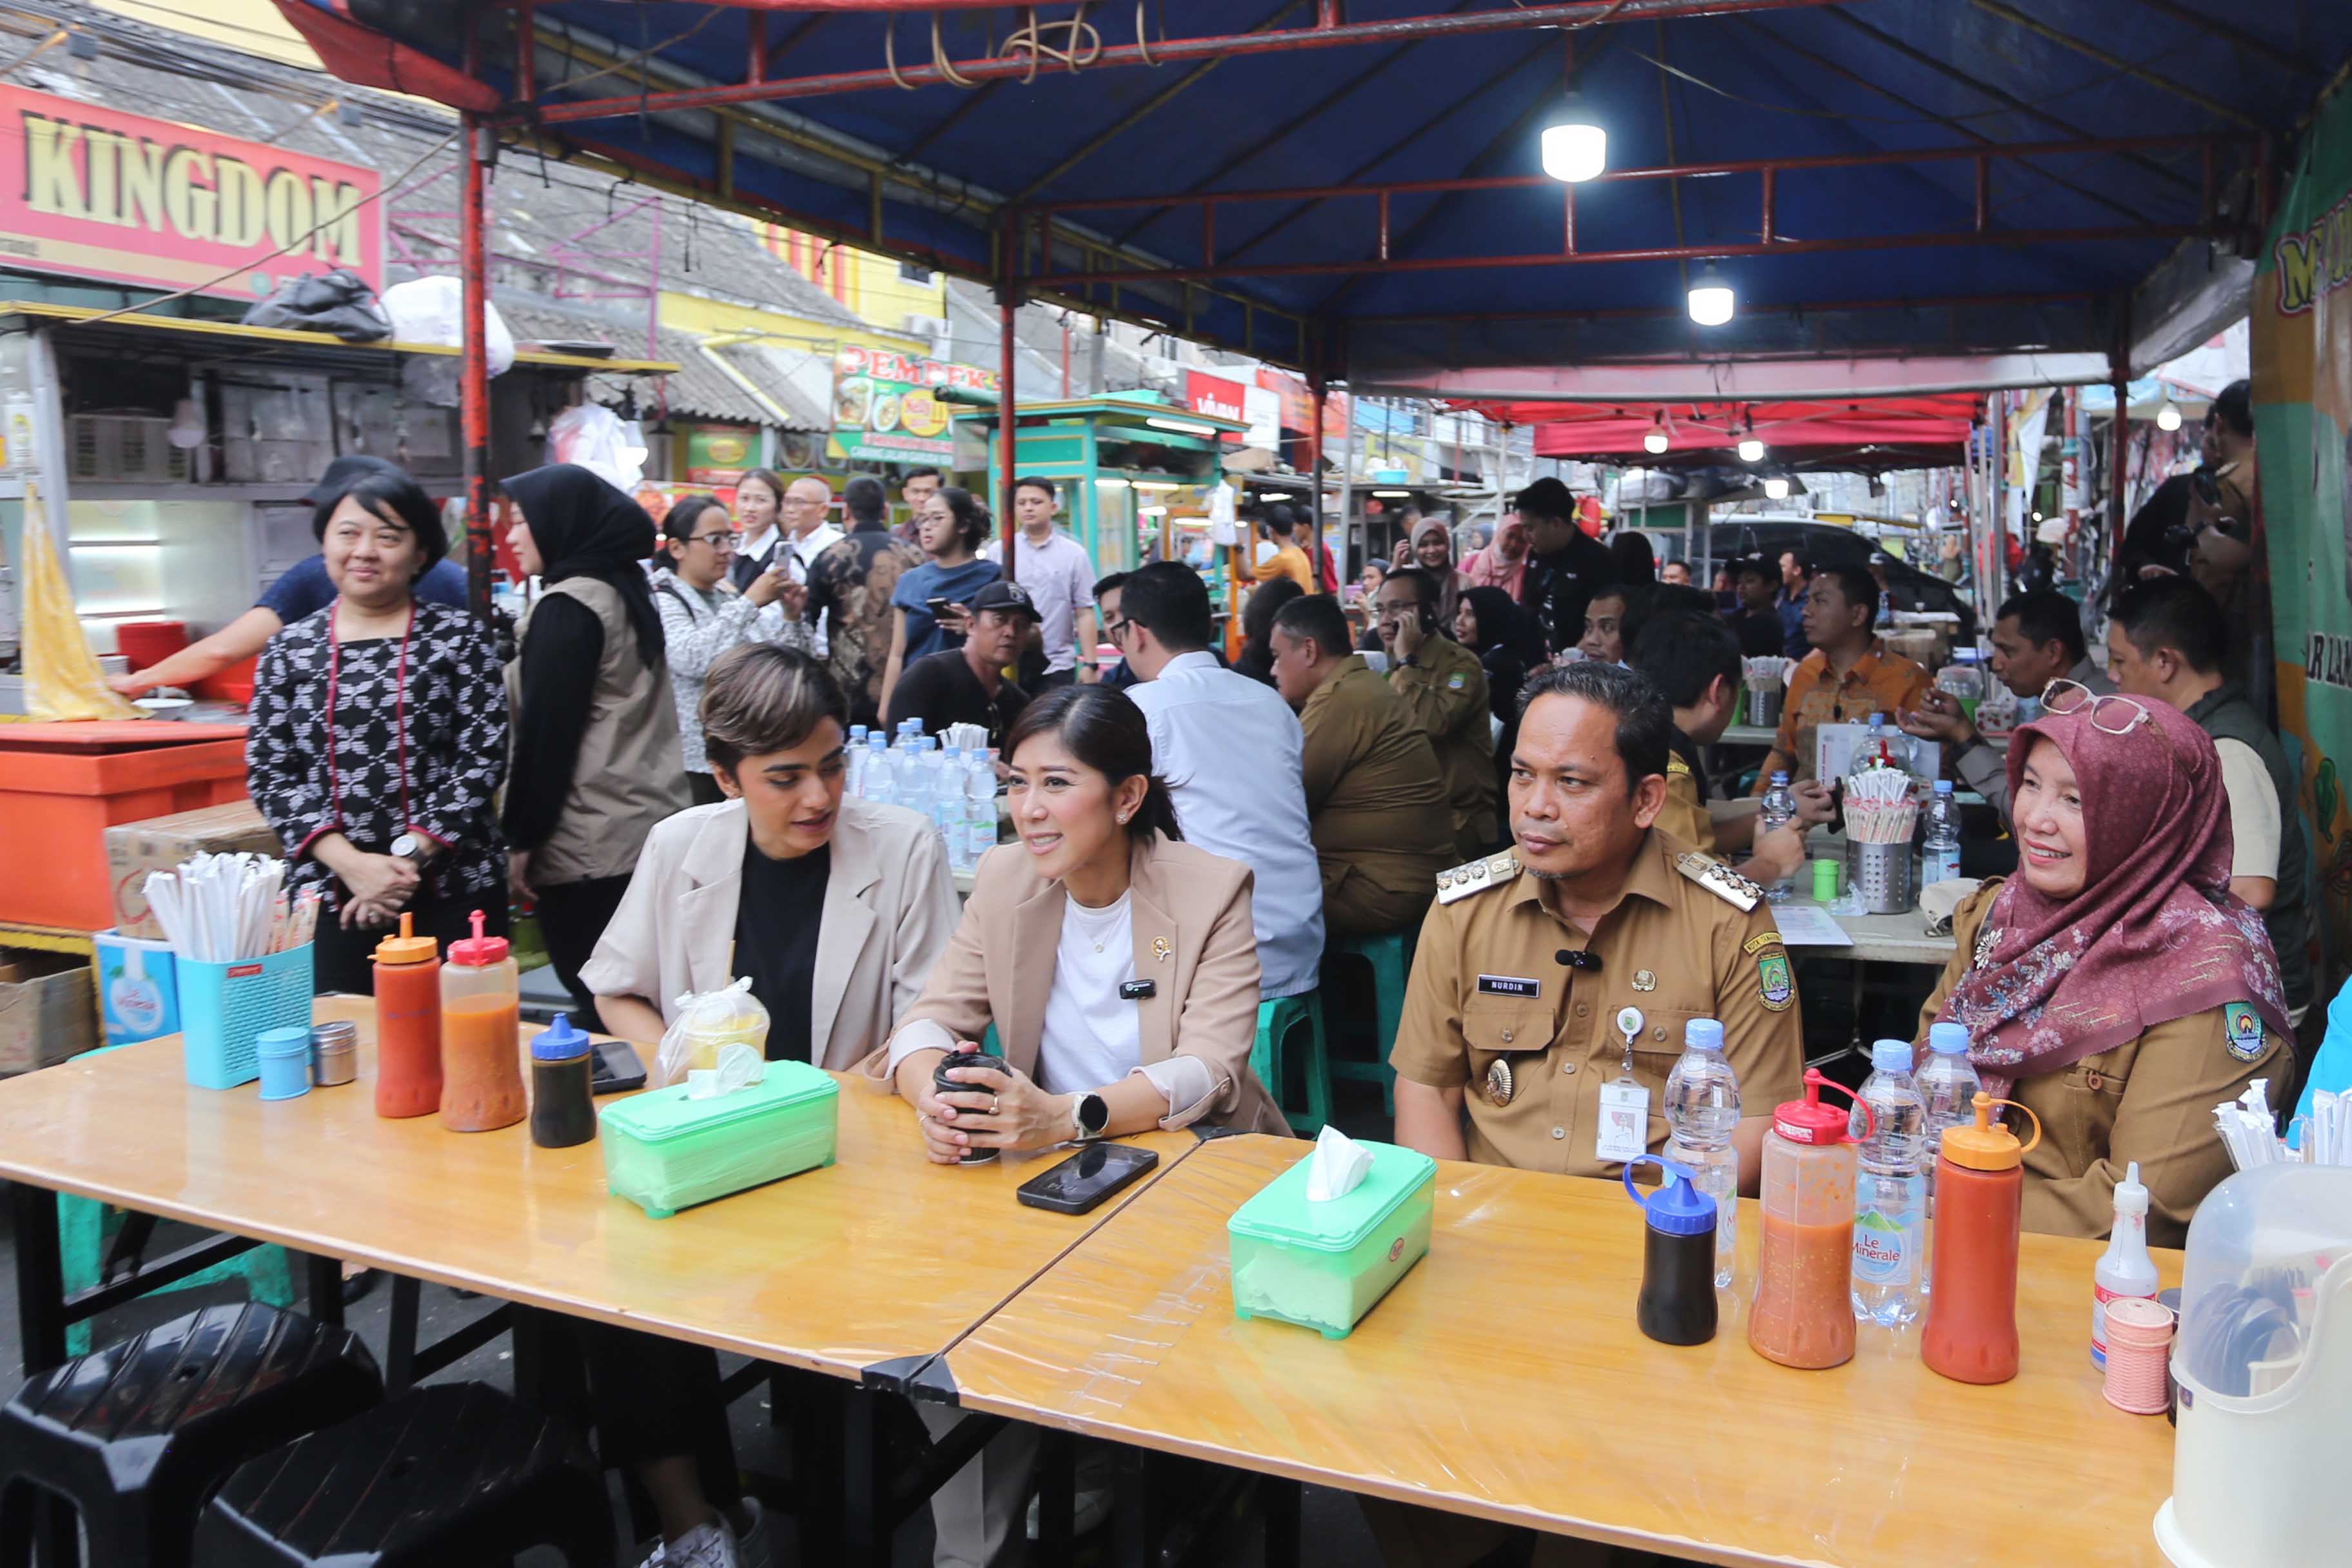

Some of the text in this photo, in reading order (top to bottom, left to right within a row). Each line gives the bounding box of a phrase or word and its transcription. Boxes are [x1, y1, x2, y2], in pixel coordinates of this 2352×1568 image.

[21, 110, 362, 268] KINGDOM
[1491, 981, 1524, 992] NURDIN
[1864, 1233, 1879, 1248] Le
